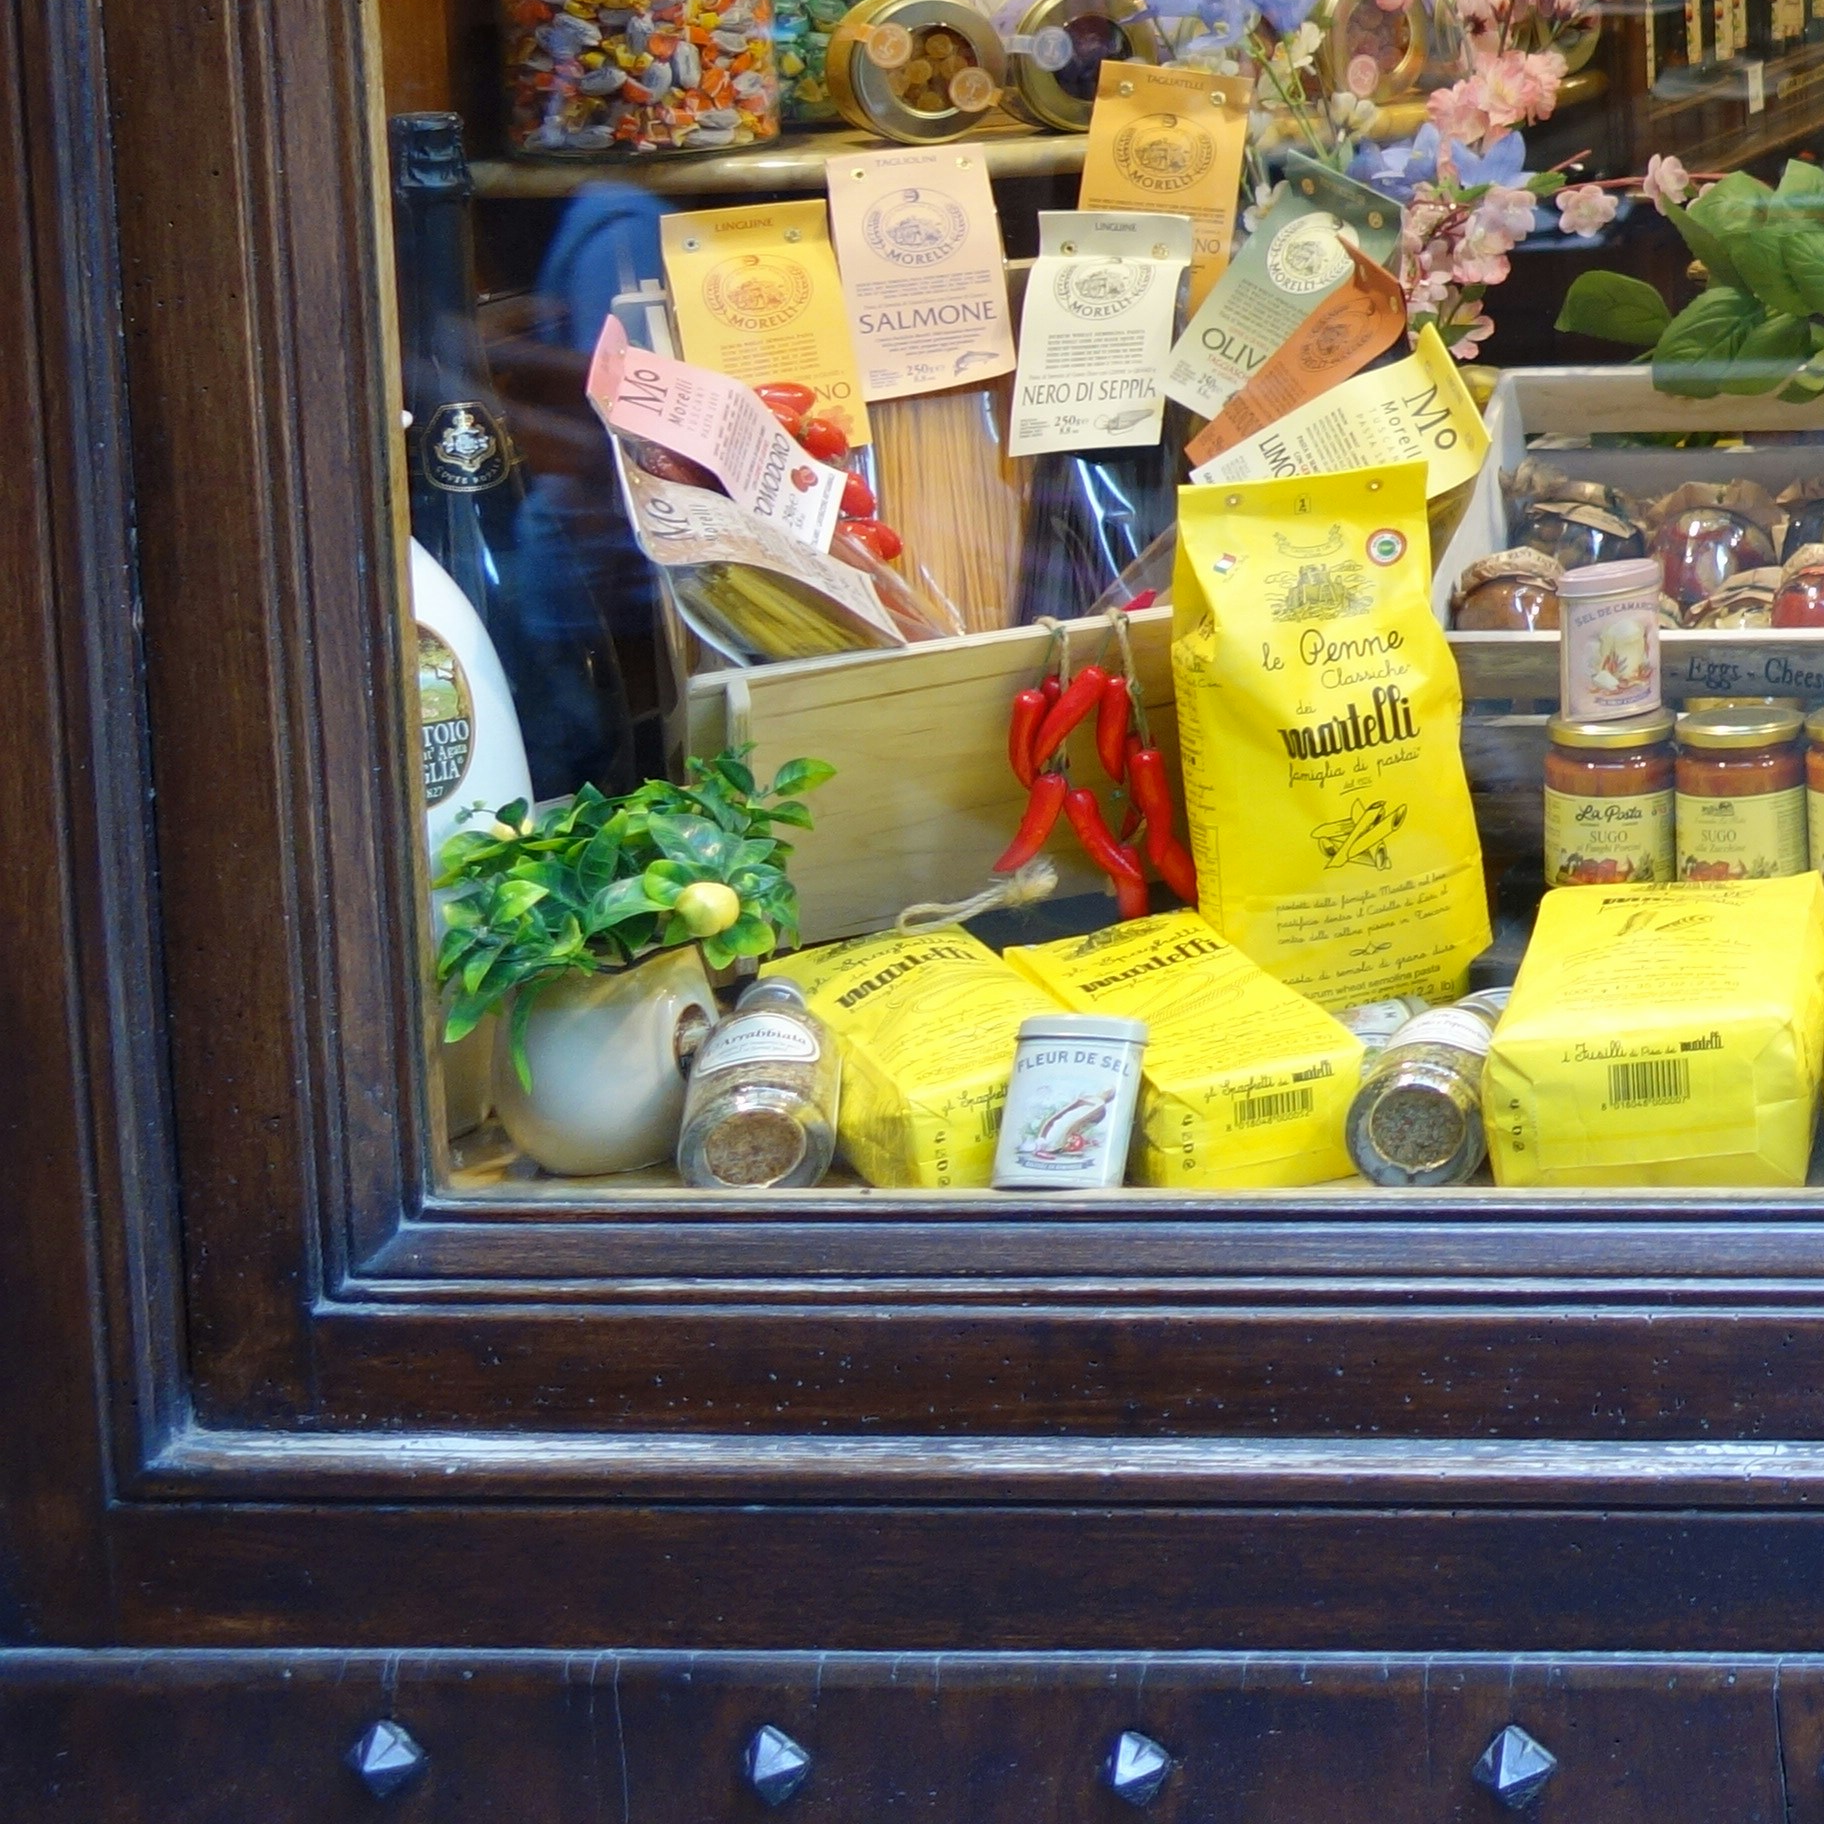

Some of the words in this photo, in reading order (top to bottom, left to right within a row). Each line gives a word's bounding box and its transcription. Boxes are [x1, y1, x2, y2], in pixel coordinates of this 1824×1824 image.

[875, 155, 937, 168] TAGLIOLINI
[1129, 171, 1196, 192] MORELLI
[714, 218, 775, 233] LINGUINE
[1095, 221, 1137, 233] LINGUINE
[886, 244, 954, 266] MORELLI
[1268, 261, 1318, 295] MORELLI
[730, 305, 798, 332] MORELLI
[858, 300, 998, 336] SALMONE
[1069, 297, 1132, 322] MORELLI
[1201, 326, 1268, 371] OLIV
[617, 369, 668, 417] Mo
[668, 377, 694, 427] Morelli
[1021, 384, 1070, 407] NERO
[1076, 382, 1095, 403] DI
[1098, 377, 1157, 401] SEPPIA
[1402, 383, 1457, 451] Mo
[754, 432, 792, 517] POMODORO
[1575, 612, 1597, 629] SEL
[1598, 607, 1613, 618] DE
[1262, 642, 1285, 672] le
[1300, 628, 1404, 666] Penne
[1321, 659, 1411, 689] Classiche
[1687, 657, 1741, 689] Eggs
[1277, 684, 1421, 761] martelli
[1288, 760, 1345, 789] famiglia
[1353, 756, 1368, 773] di
[1377, 746, 1421, 776] pastai
[1576, 804, 1601, 822] La
[1605, 804, 1643, 823] Posta
[1589, 830, 1628, 844] SUGO
[1701, 830, 1737, 843] SUGO
[1709, 843, 1746, 853] Zucchine
[1076, 937, 1234, 994] martelli
[1395, 952, 1427, 970] grano
[1336, 981, 1367, 995] wheat
[1368, 971, 1413, 988] semolina
[1414, 964, 1441, 979] pasta
[1574, 1040, 1627, 1064] Fusilli
[1680, 1031, 1725, 1053] martelli
[1017, 1050, 1068, 1074] FLEUR
[1074, 1051, 1098, 1066] DE
[1101, 1053, 1130, 1077] SEL
[1221, 1075, 1275, 1098] Spaghetti
[1291, 1060, 1335, 1085] martelli
